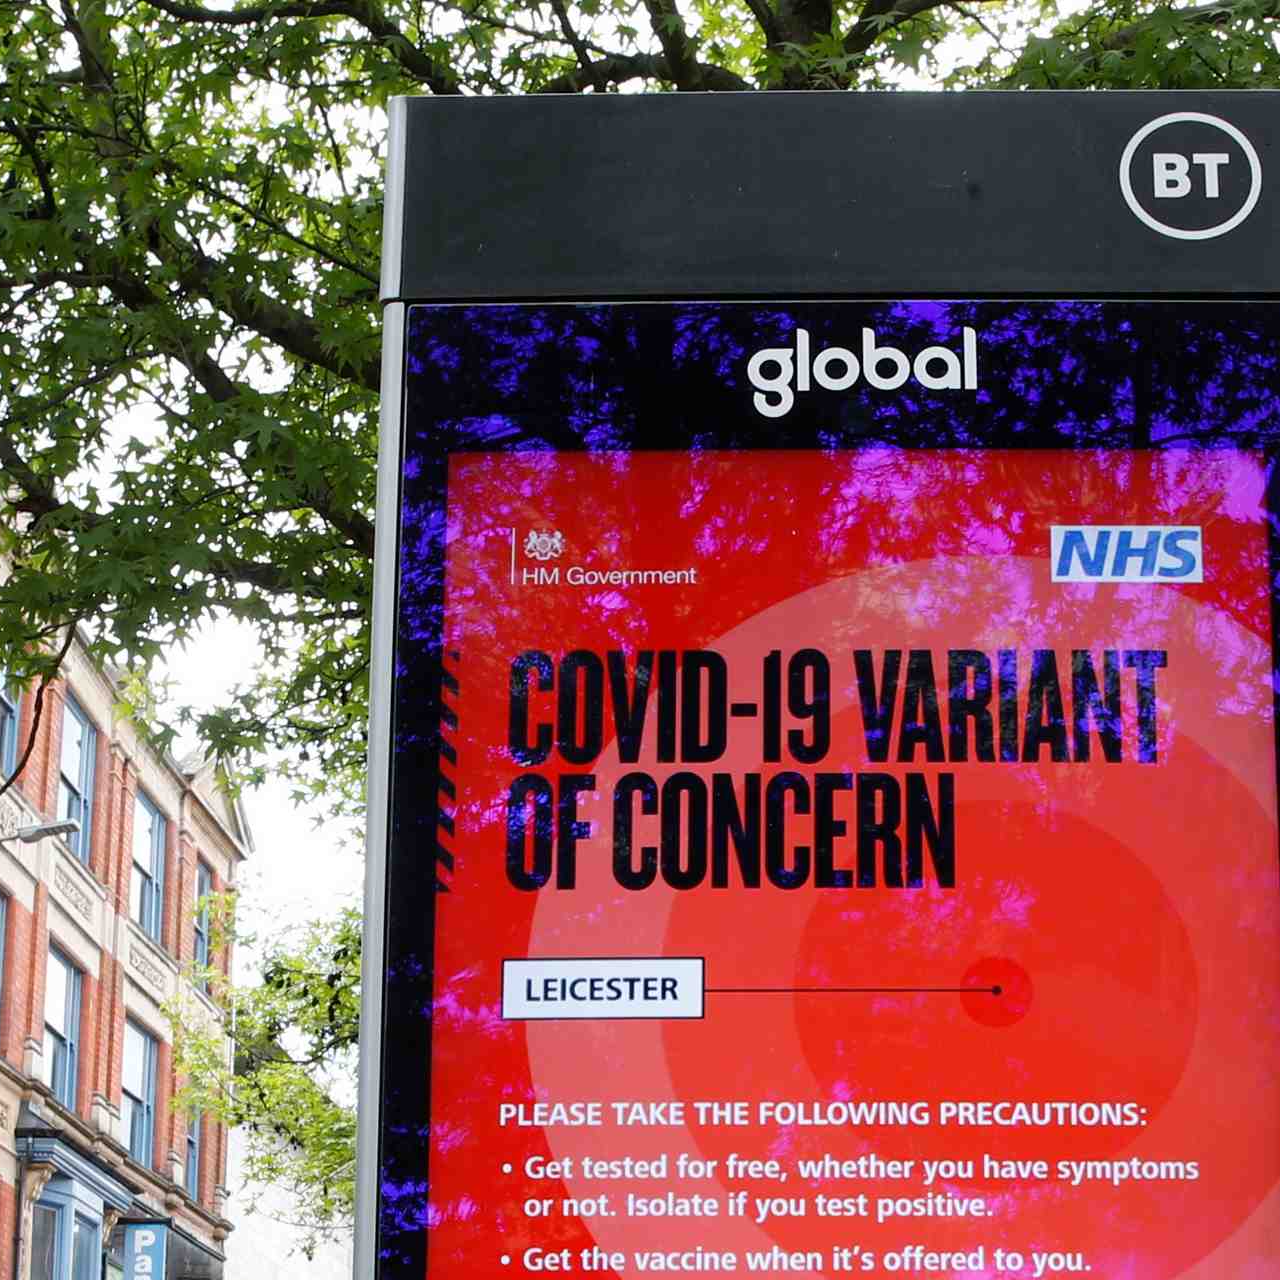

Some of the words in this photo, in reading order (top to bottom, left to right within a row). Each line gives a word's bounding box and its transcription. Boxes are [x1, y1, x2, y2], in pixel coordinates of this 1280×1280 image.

[1152, 153, 1230, 199] BT
[747, 326, 978, 418] global
[1055, 528, 1201, 579] NHS
[522, 567, 559, 585] HM
[566, 566, 697, 585] Government
[507, 648, 831, 765] COVID-19
[852, 648, 1168, 765] VARIANT
[506, 771, 596, 891] OF
[613, 771, 956, 890] CONCERN
[525, 976, 679, 1002] LEICESTER
[499, 1103, 601, 1126] PLEASE
[611, 1103, 684, 1126] TAKE
[694, 1103, 748, 1126] THE
[759, 1102, 929, 1126] FOLLOWING
[939, 1102, 1148, 1126] PRECAUTIONS:
[524, 1156, 573, 1179] Get
[582, 1154, 667, 1179] tested
[676, 1154, 718, 1178] for
[726, 1154, 788, 1182] free,
[798, 1154, 914, 1179] whether
[923, 1160, 974, 1184] you
[983, 1154, 1048, 1179] have
[1056, 1157, 1199, 1185] symptoms
[524, 1197, 553, 1217] or
[563, 1194, 616, 1217] not.
[627, 1192, 719, 1217] Isolate
[728, 1192, 748, 1216] if
[756, 1198, 806, 1223] you
[815, 1195, 868, 1217] test
[877, 1193, 993, 1222] positive.
[523, 1248, 571, 1271] Get
[581, 1246, 625, 1270] the
[634, 1246, 737, 1271] vaccine
[746, 1246, 822, 1270] when
[883, 1245, 985, 1271] offered
[993, 1249, 1024, 1271] to
[1031, 1252, 1092, 1277] you.
